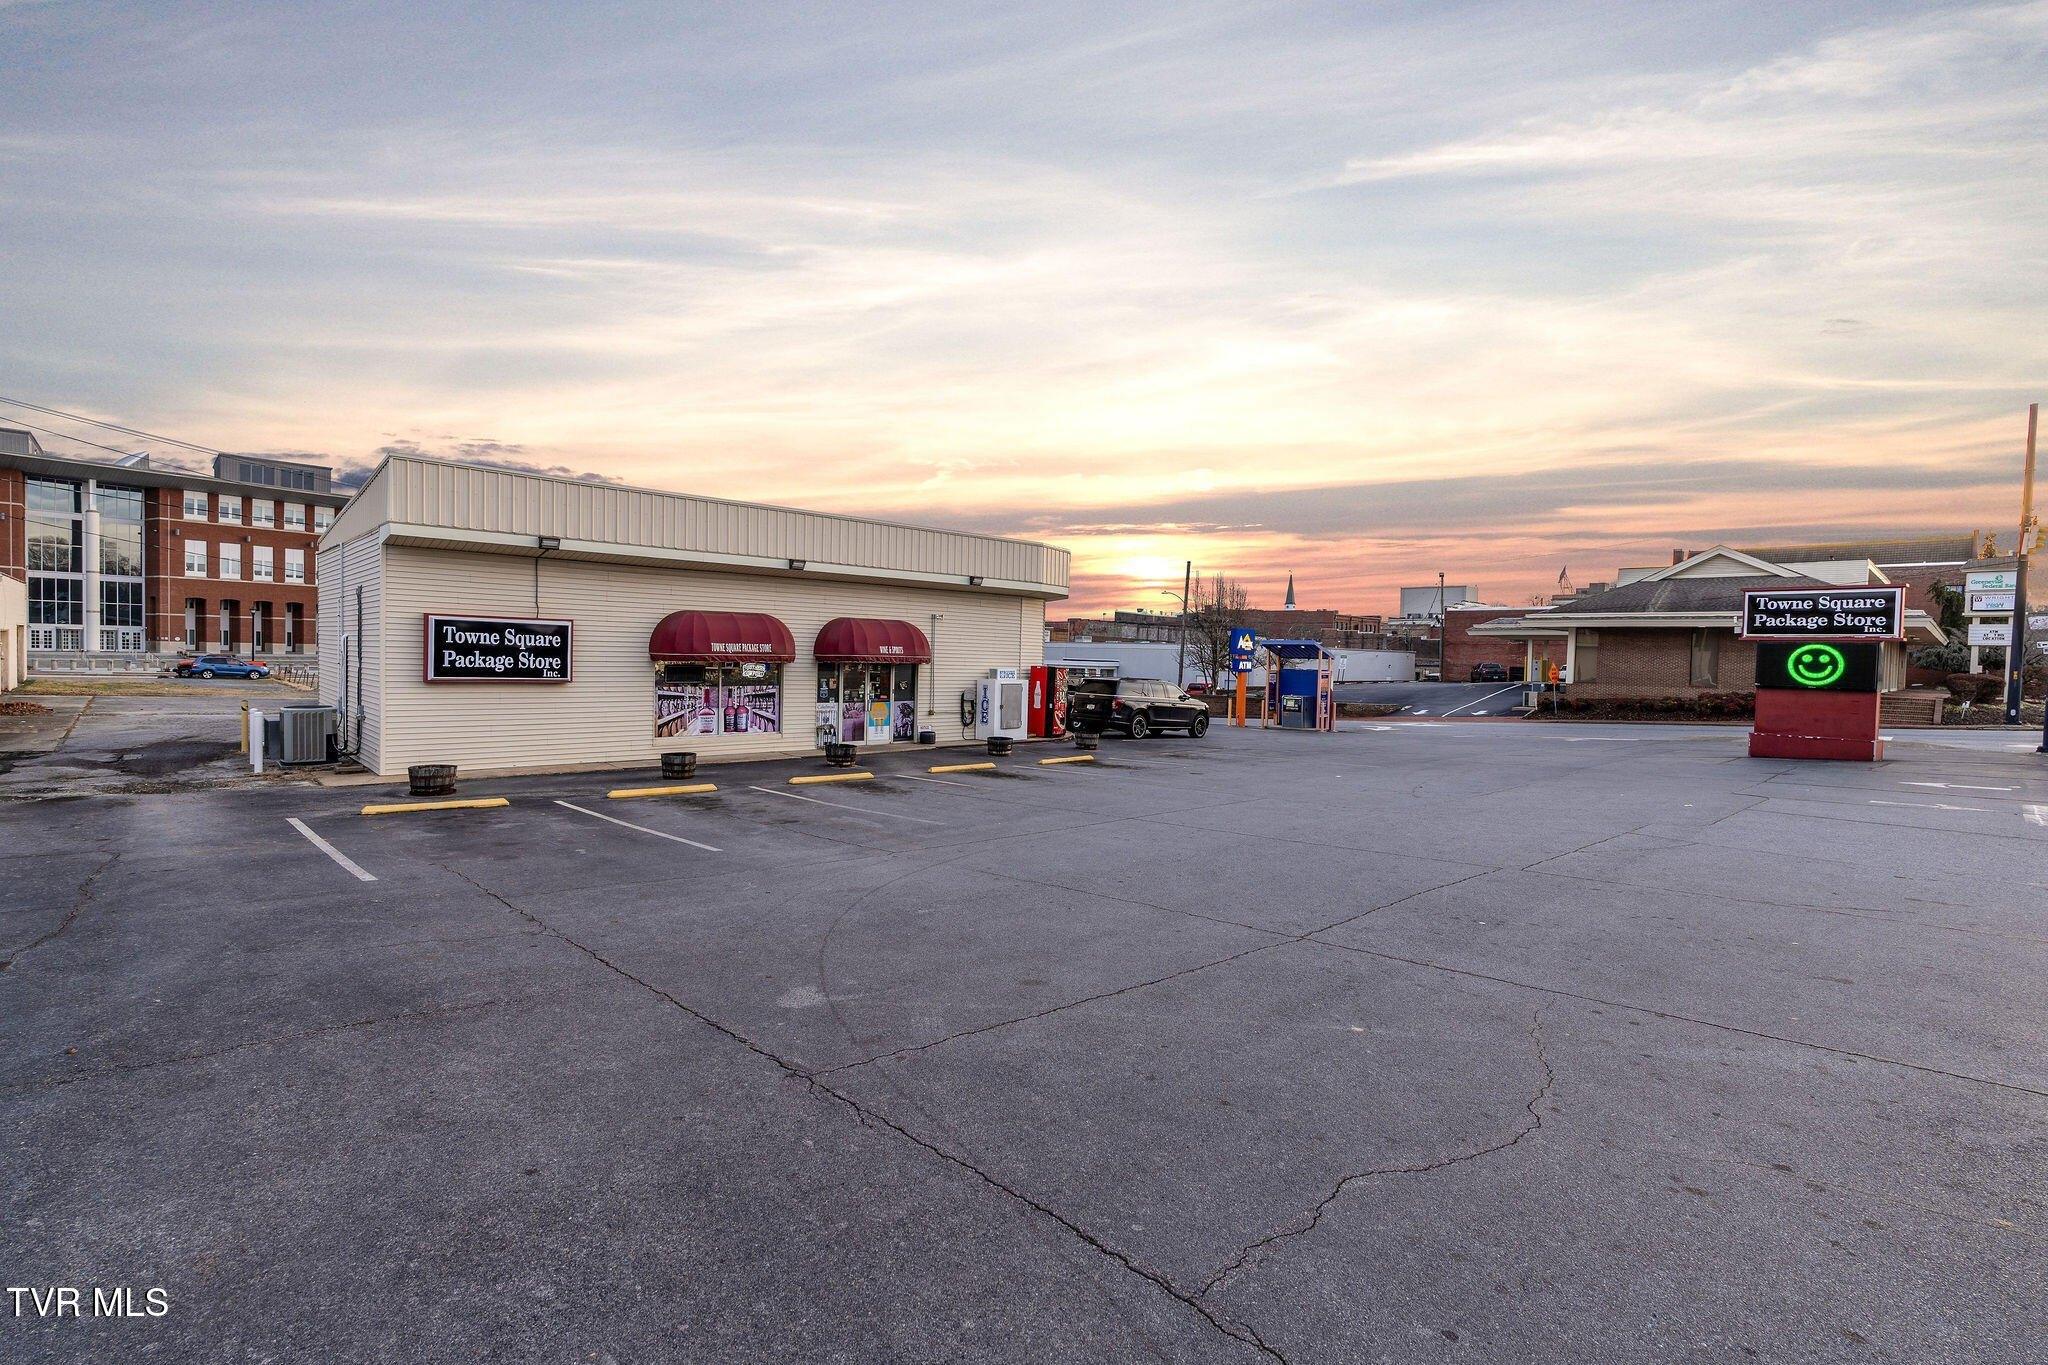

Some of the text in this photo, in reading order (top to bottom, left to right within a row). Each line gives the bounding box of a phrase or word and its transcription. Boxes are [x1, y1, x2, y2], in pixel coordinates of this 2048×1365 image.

[1756, 595, 1886, 612] Towne Square
[1754, 612, 1887, 629] Package Store
[443, 626, 561, 650] Towne Square
[711, 642, 772, 654] TOWNE SQUARE PACKAGE STORE
[442, 650, 561, 672] Package Store
[1238, 662, 1252, 670] ATM
[542, 669, 561, 677] Inc.
[981, 684, 989, 726] ICE
